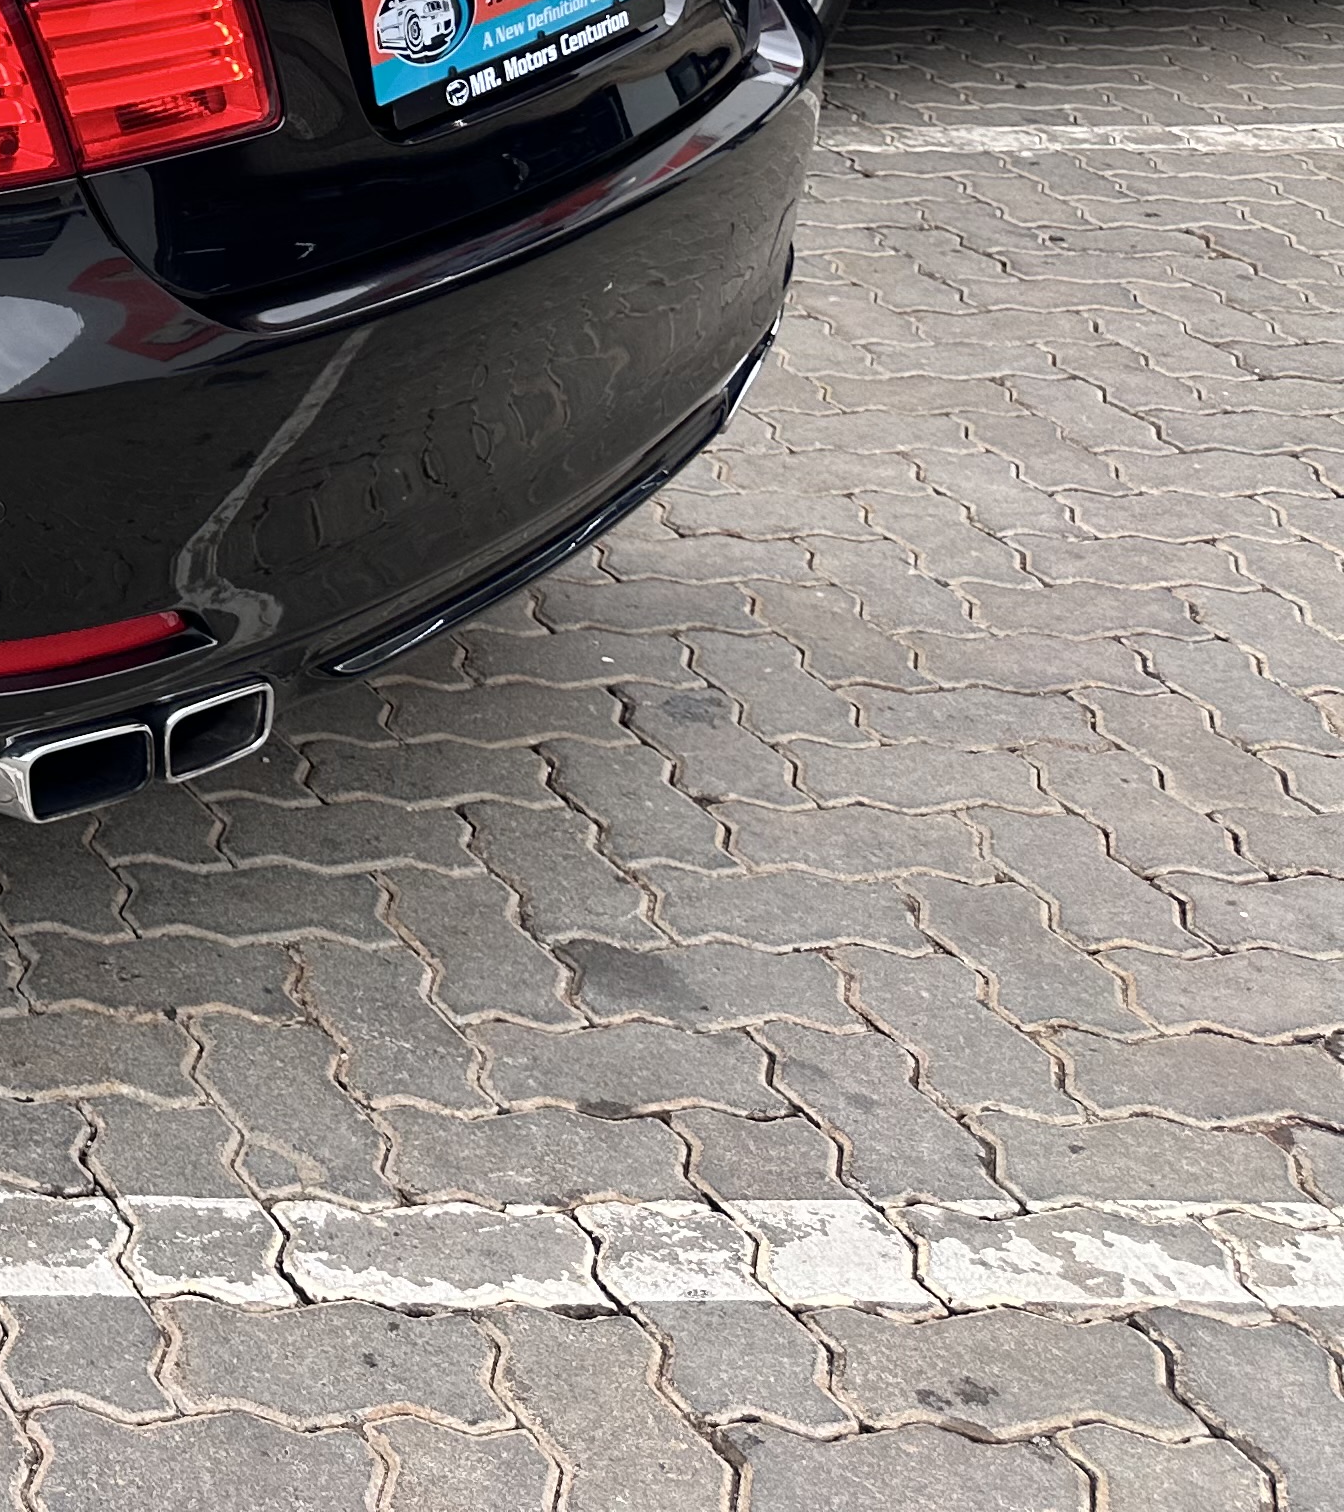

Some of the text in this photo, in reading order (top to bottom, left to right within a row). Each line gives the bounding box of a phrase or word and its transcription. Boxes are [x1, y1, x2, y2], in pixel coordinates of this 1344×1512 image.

[469, 9, 631, 98] MR. Motors Centurion
[482, 31, 494, 51] A
[495, 23, 525, 45] New
